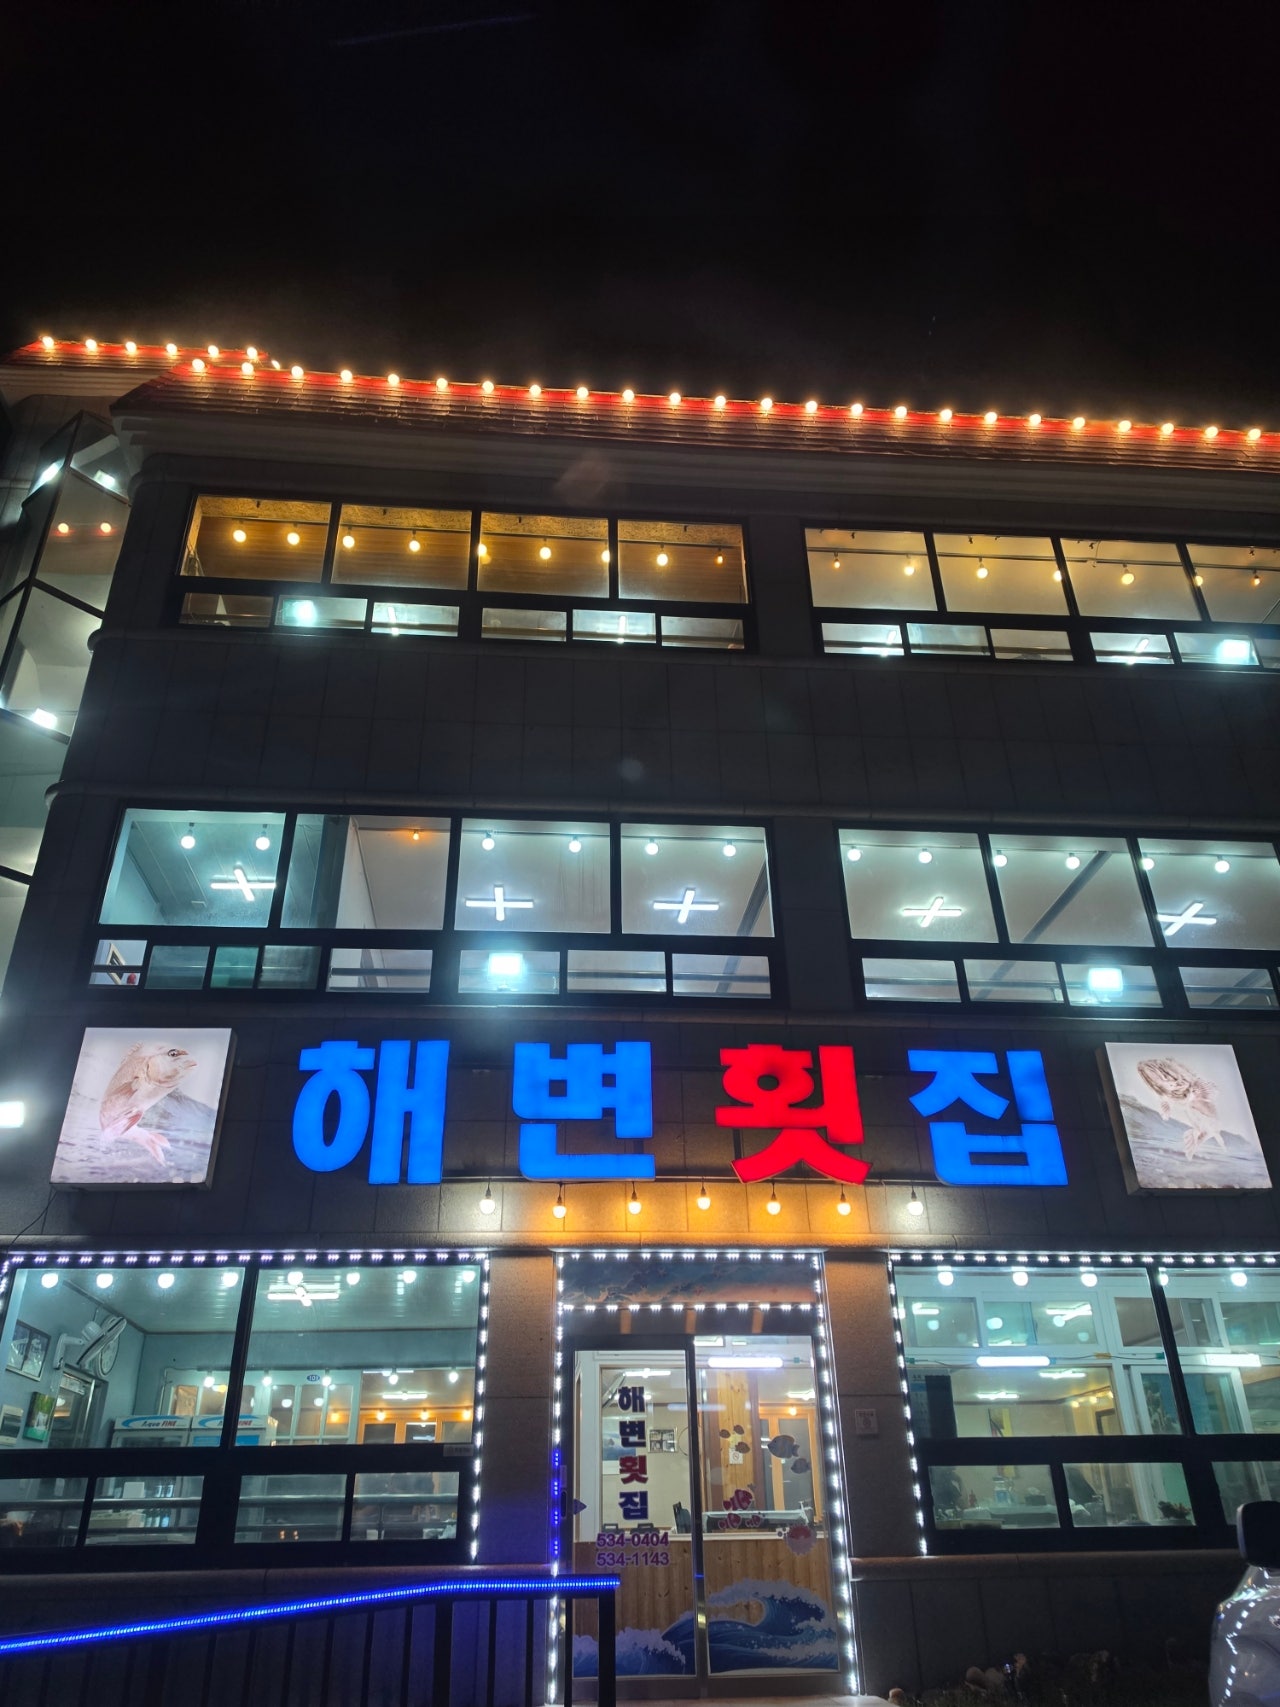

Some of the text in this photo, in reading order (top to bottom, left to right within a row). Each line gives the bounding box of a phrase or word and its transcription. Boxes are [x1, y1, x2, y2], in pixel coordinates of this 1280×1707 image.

[292, 1040, 1069, 1186] 해변횟집
[618, 1386, 649, 1520] 해변횟집
[597, 1532, 670, 1547] 534-0404
[597, 1552, 670, 1567] 534-1143
